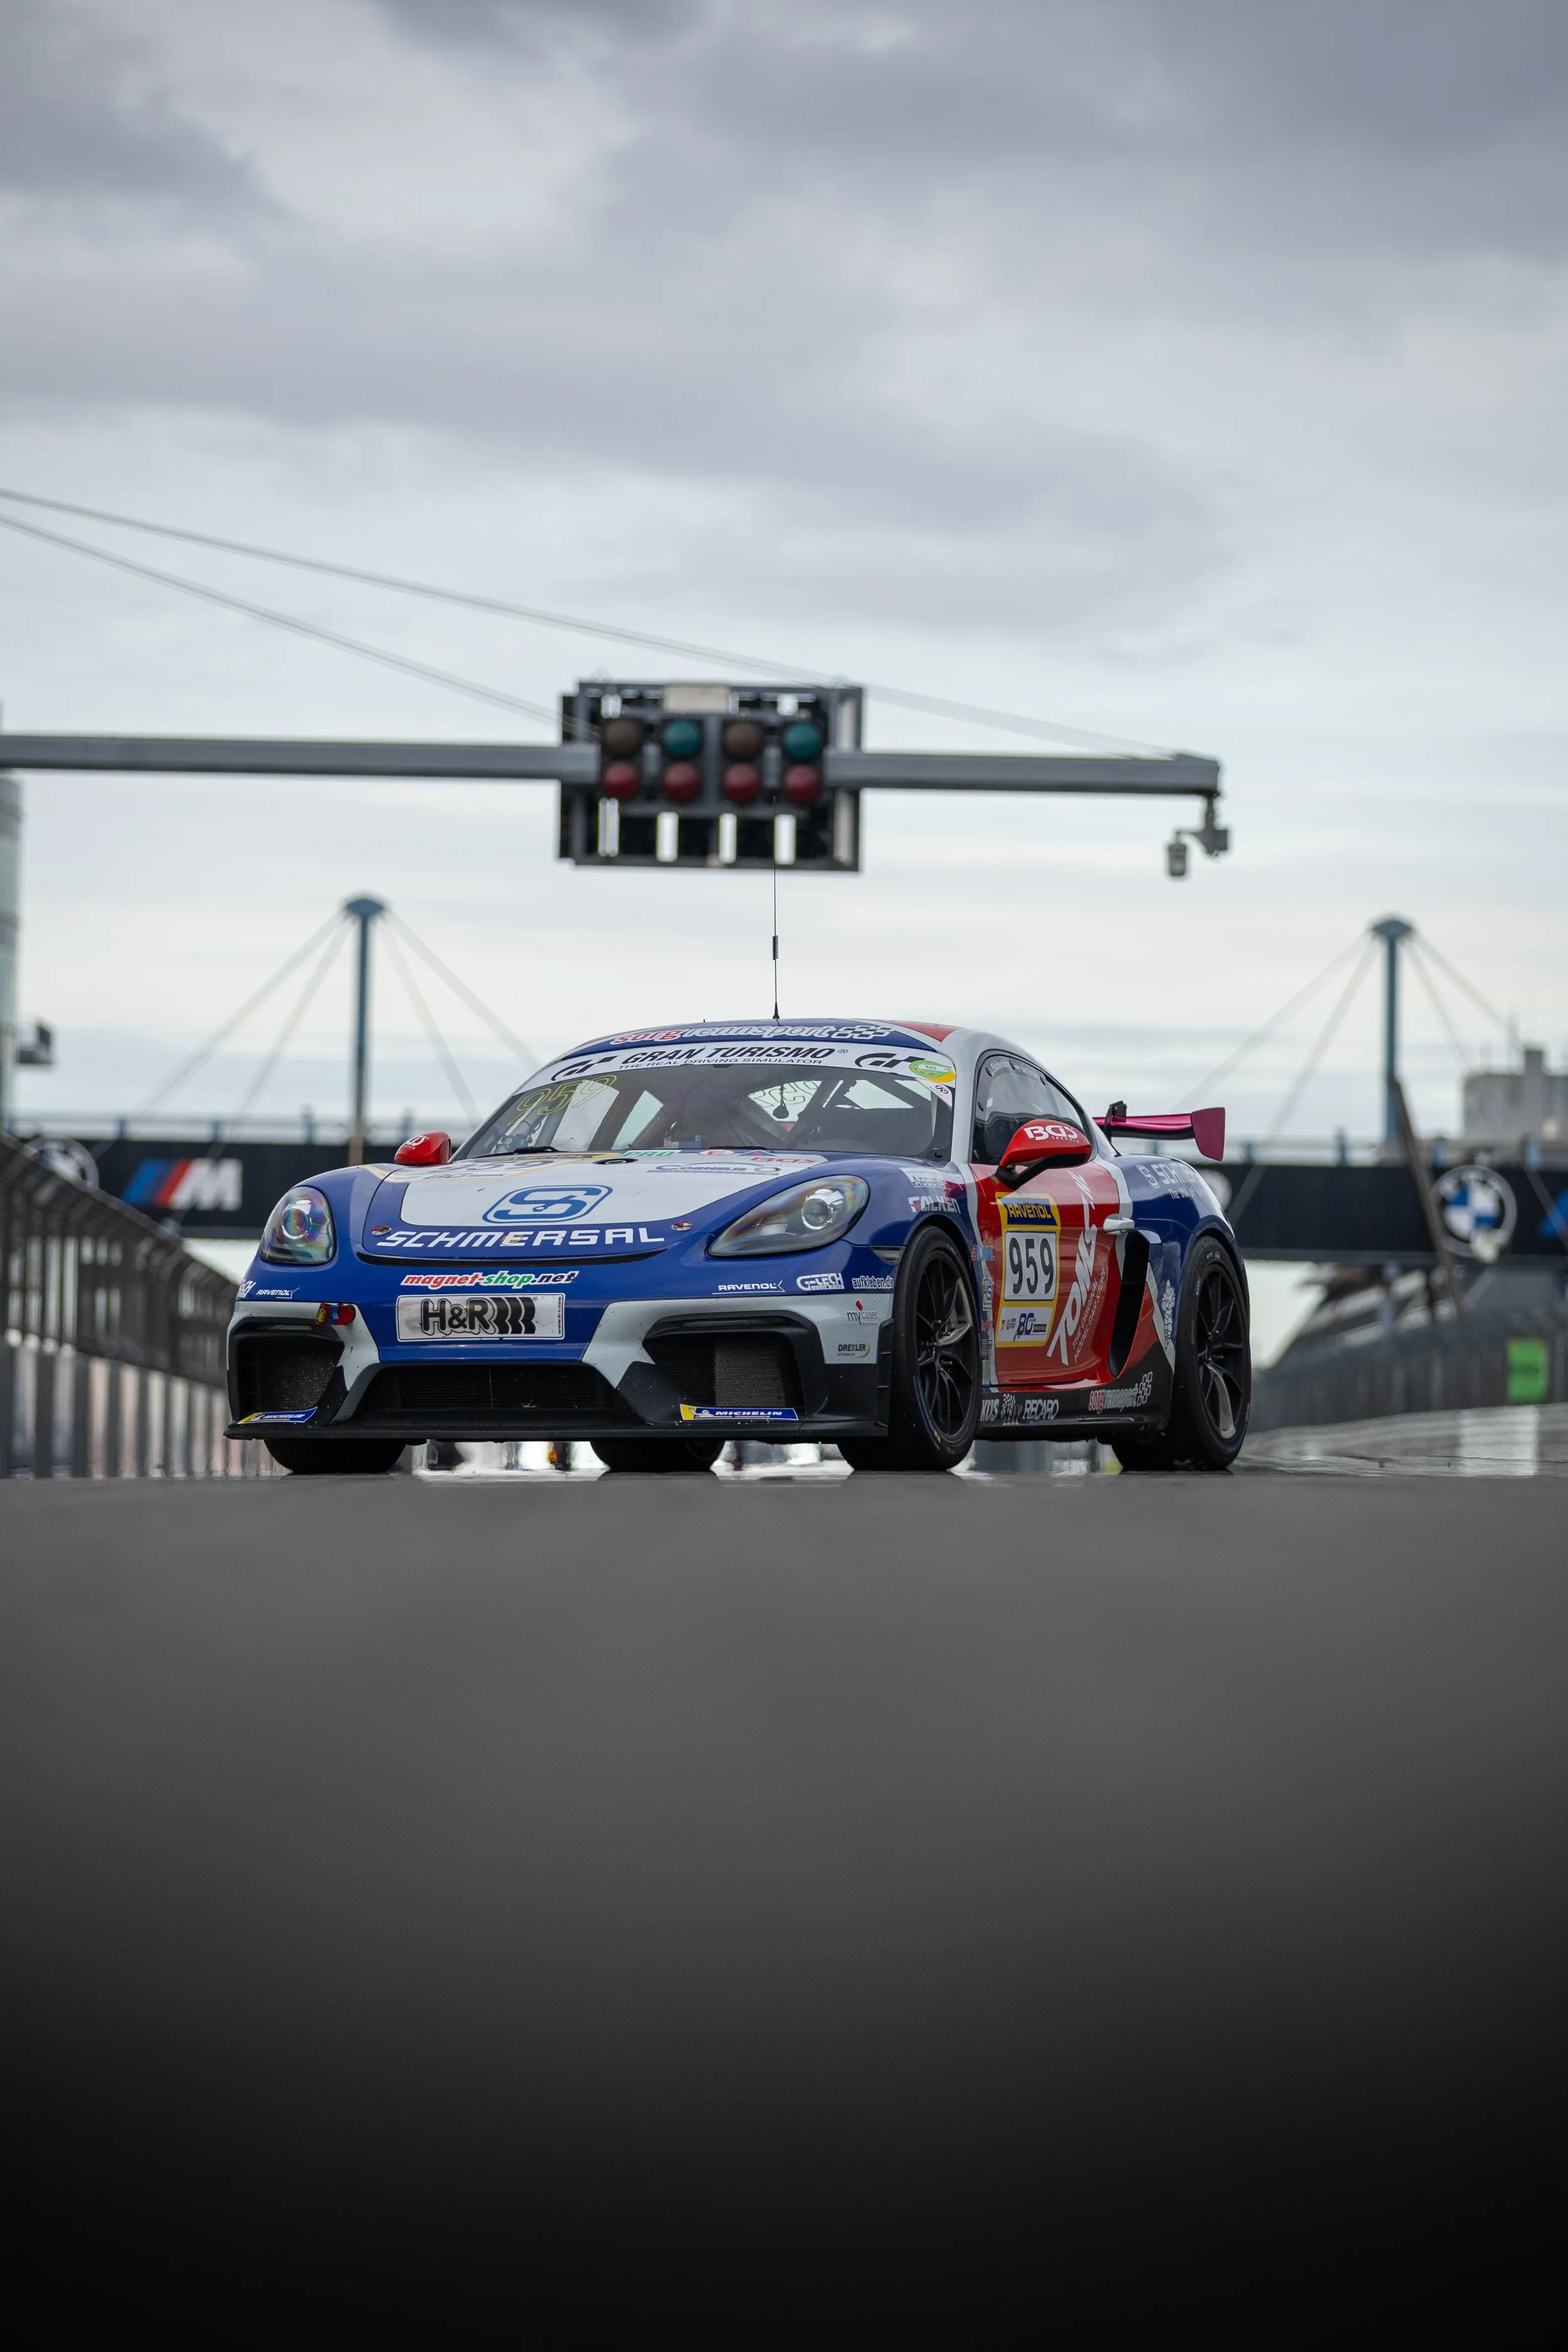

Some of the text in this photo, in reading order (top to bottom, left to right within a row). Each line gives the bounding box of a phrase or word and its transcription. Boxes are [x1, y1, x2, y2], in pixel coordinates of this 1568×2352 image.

[622, 1046, 836, 1064] GRAN TURISMO
[507, 1074, 618, 1126] 959
[428, 1160, 554, 1173] 959
[908, 1195, 961, 1214] FALKEN
[1007, 1204, 1052, 1219] RAVENOL
[377, 1227, 665, 1248] SCHMERSAL
[1009, 1237, 1054, 1294] 959
[403, 1271, 578, 1289] magnet-shop.net
[718, 1283, 776, 1291] RAVENOL
[852, 1275, 894, 1290] aufkleben.de
[317, 1308, 326, 1323] OMP
[421, 1298, 499, 1336] H&R
[1072, 1278, 1098, 1350] THE ORIGINAL
[1074, 1264, 1106, 1364] MODEL CAR STORE
[838, 1343, 866, 1352] DREXLER
[1023, 1399, 1059, 1420] RECARO
